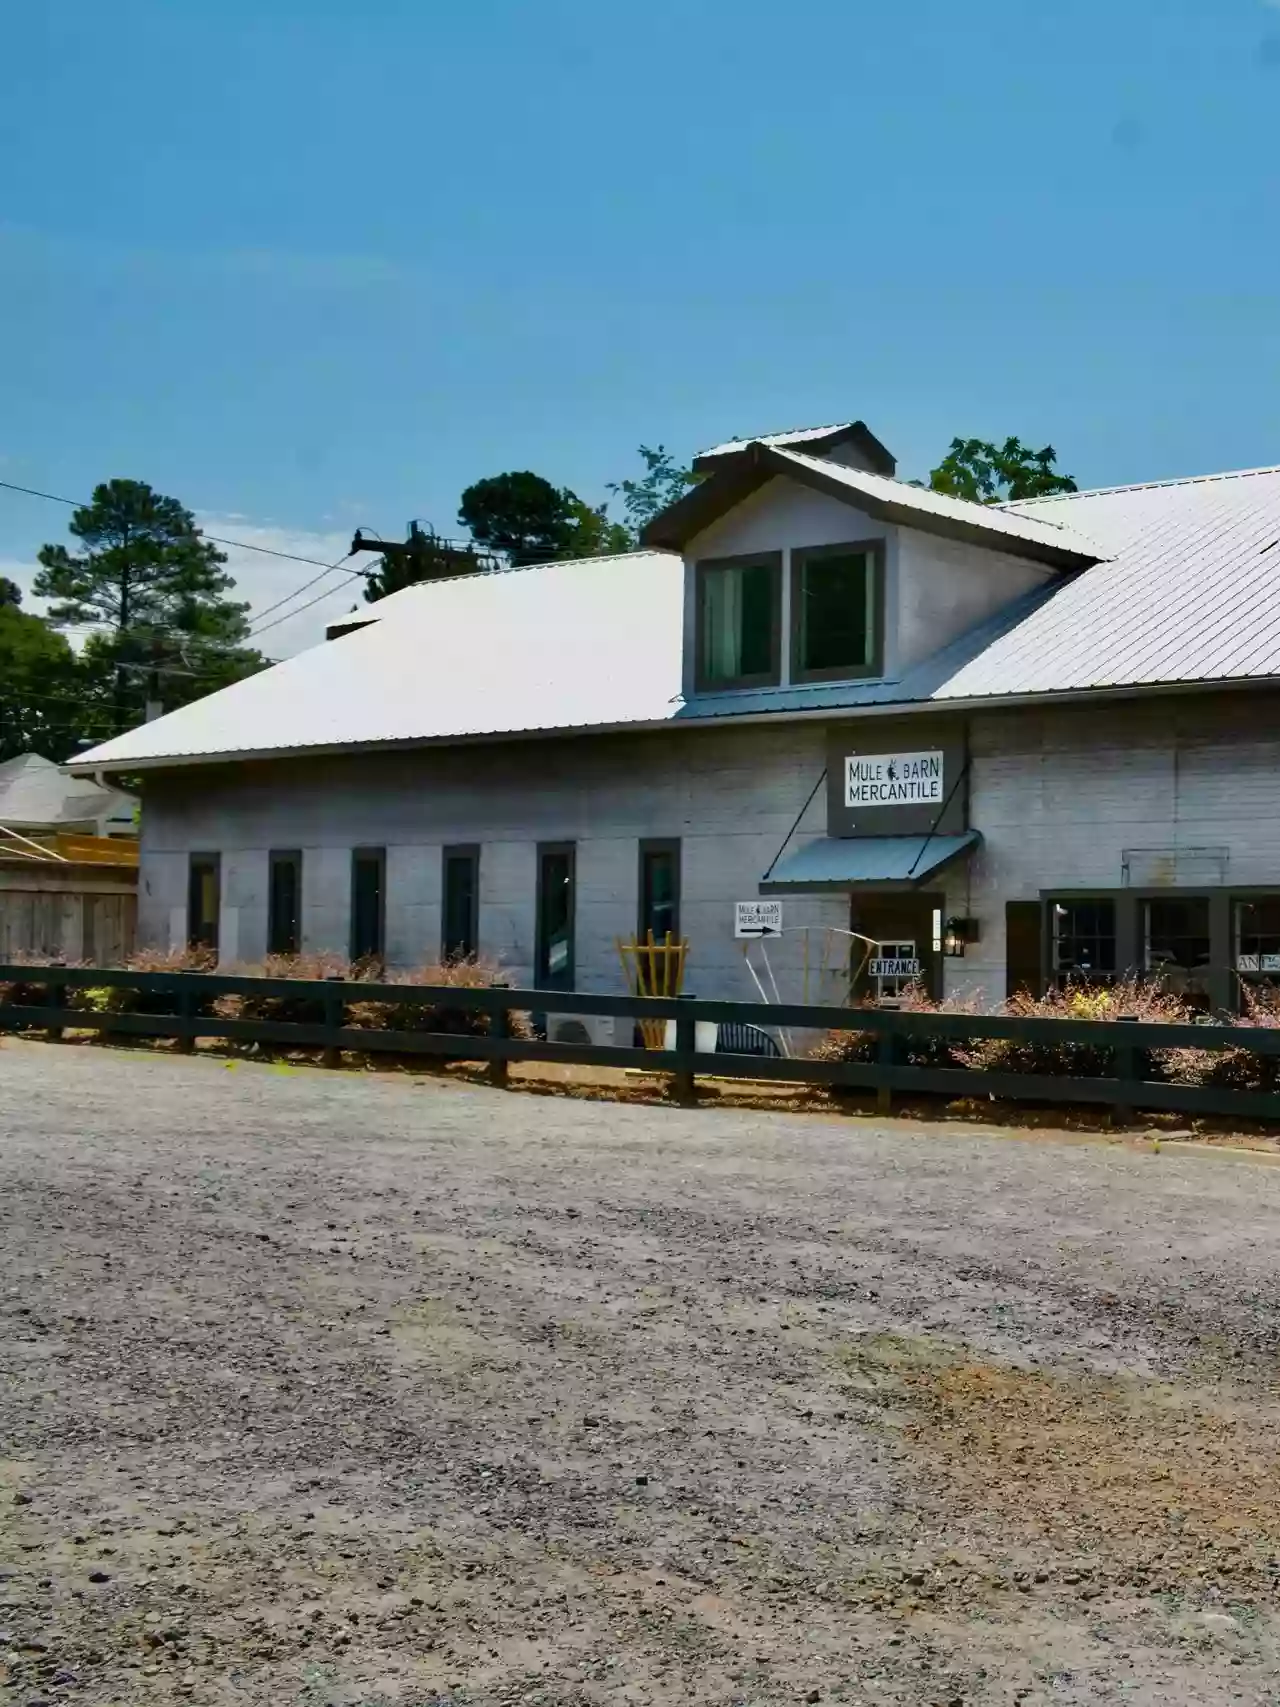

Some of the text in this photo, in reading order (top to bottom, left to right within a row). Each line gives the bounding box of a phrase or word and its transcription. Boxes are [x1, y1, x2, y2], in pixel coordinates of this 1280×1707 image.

[849, 757, 939, 781] MULE BARN
[849, 781, 939, 802] MERCANTILE
[870, 960, 917, 974] ENTRANCE
